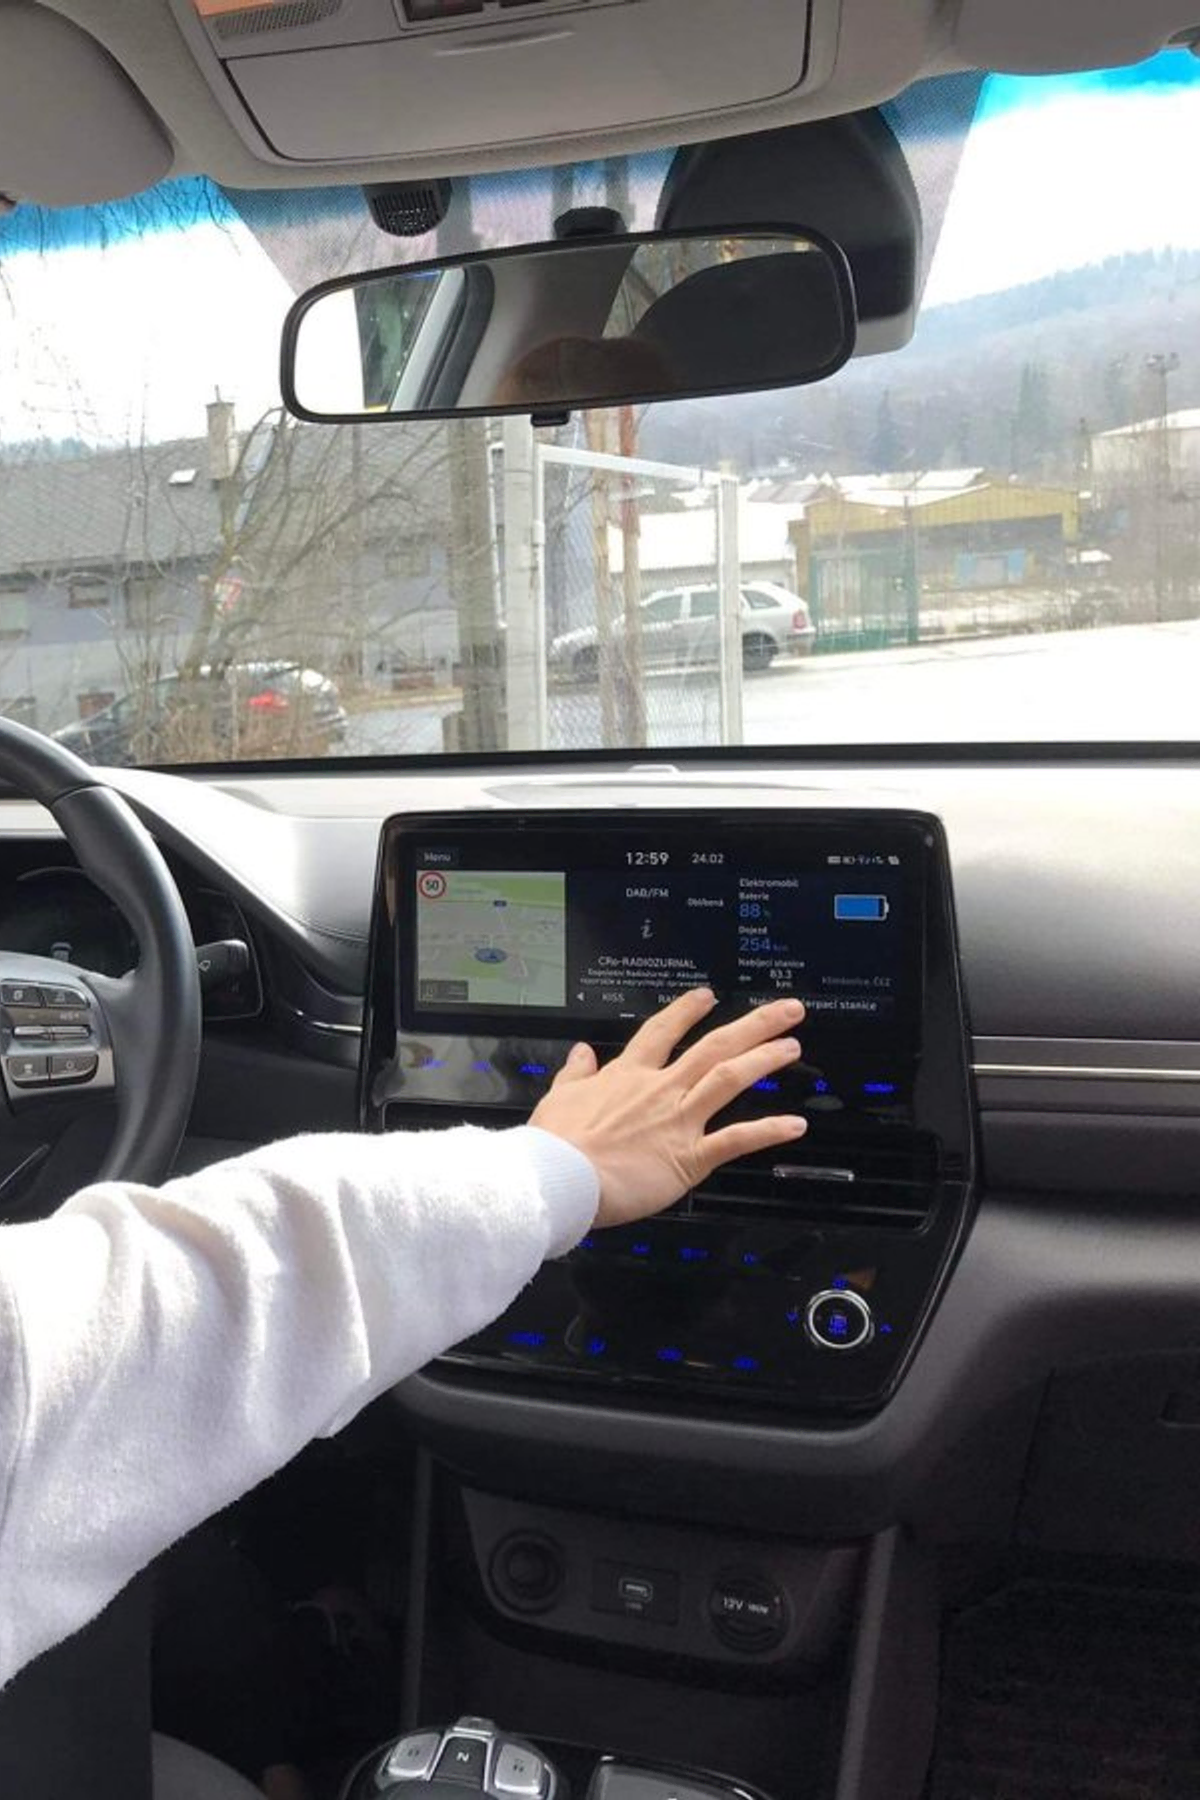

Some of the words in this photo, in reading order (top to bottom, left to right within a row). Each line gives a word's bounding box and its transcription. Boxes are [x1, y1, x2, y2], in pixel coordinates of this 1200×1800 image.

[626, 851, 669, 865] 12:59
[691, 853, 724, 865] 24.02
[426, 879, 440, 891] 50
[626, 887, 669, 898] DAB/FM
[739, 903, 761, 918] 88
[739, 937, 771, 951] 254
[456, 1751, 469, 1763] N
